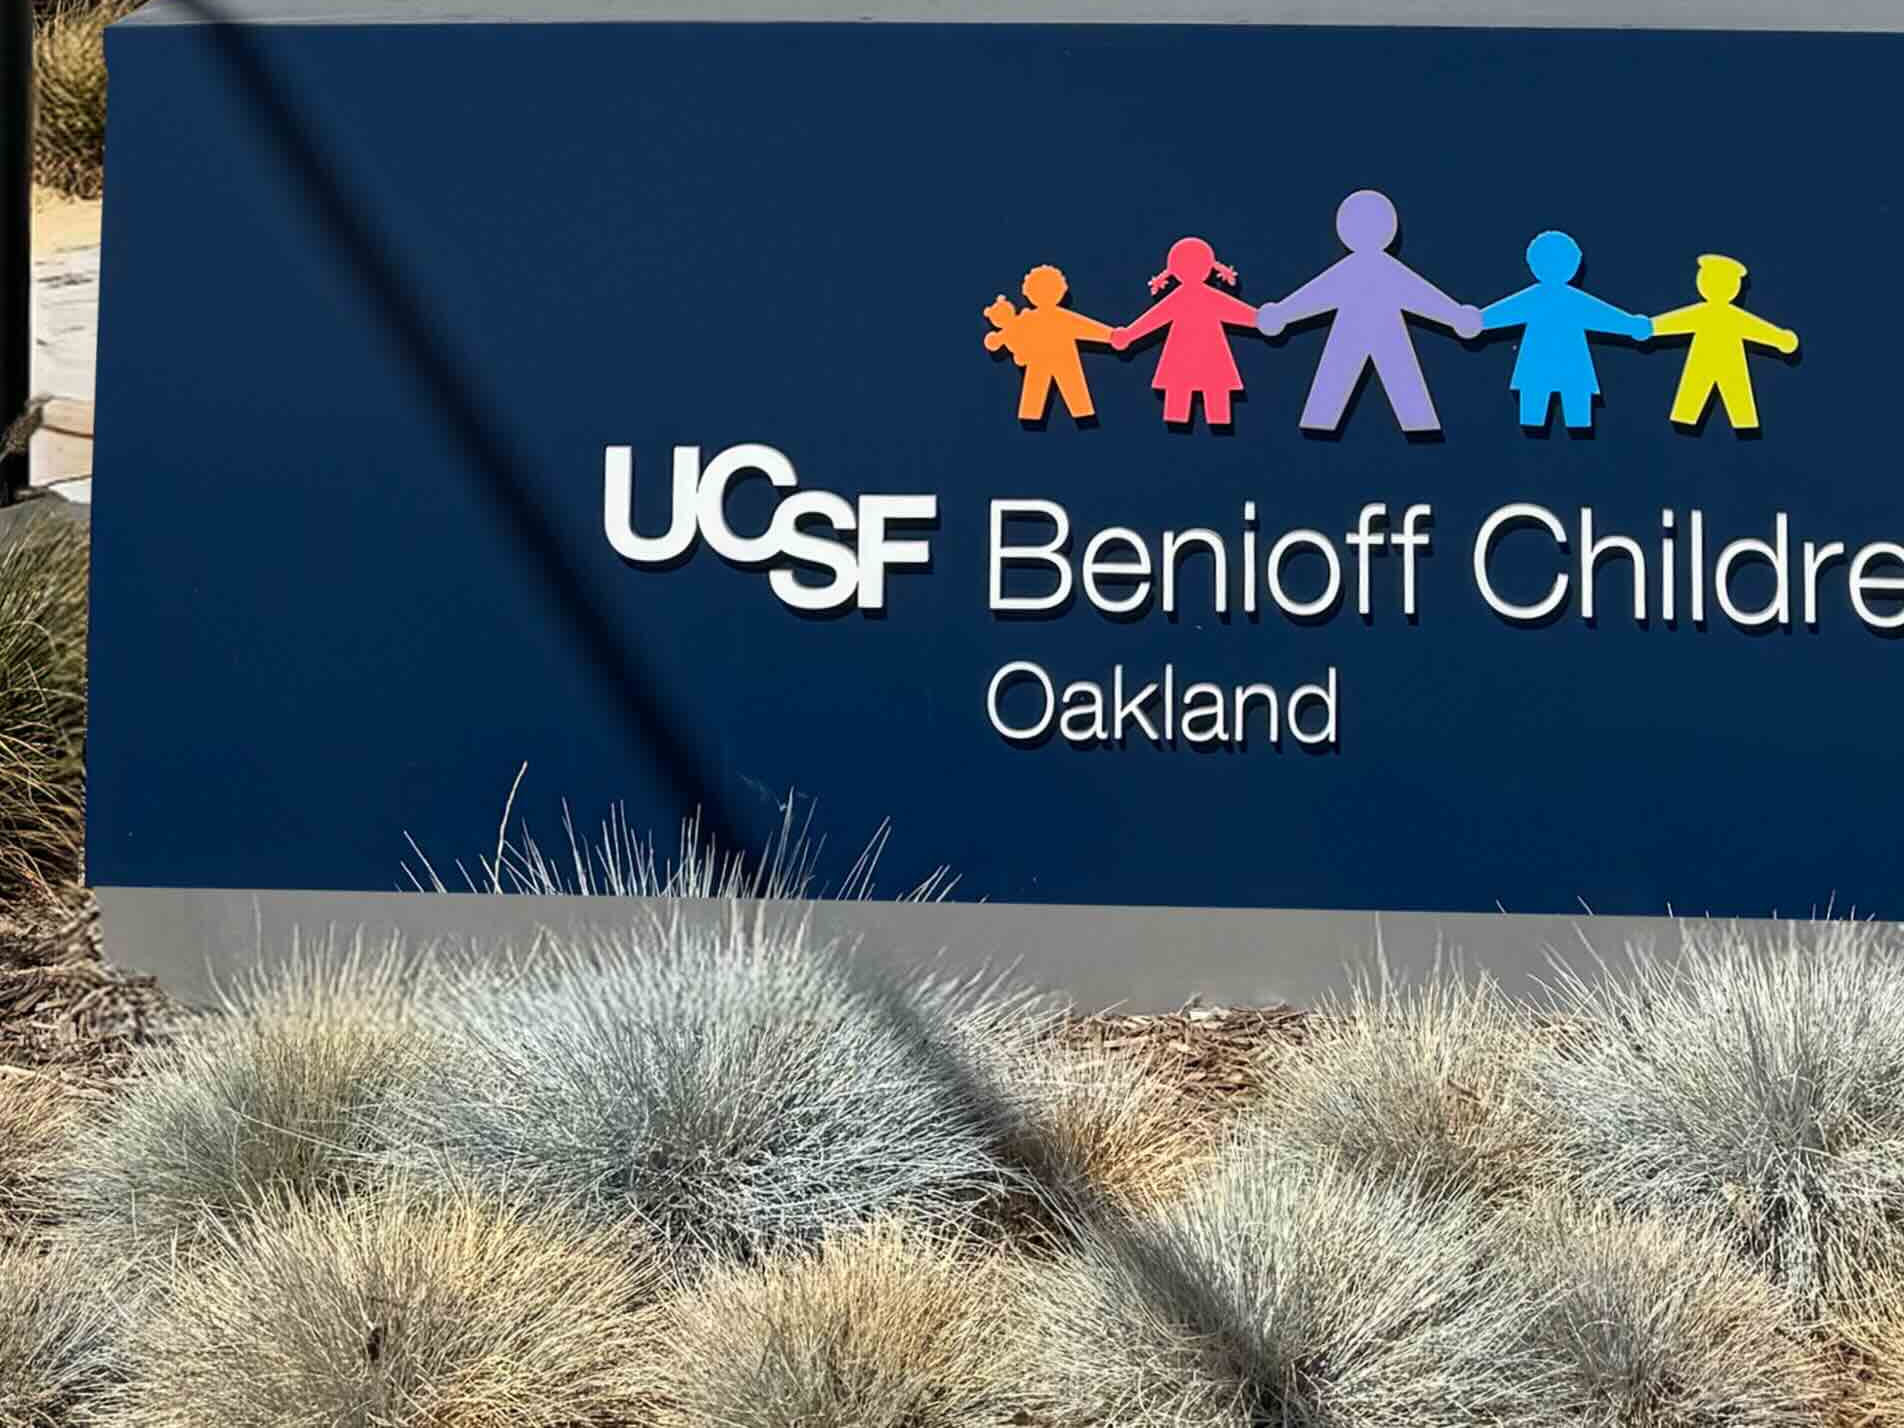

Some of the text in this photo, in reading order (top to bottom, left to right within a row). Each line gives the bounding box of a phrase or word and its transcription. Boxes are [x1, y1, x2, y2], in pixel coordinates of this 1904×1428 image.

[604, 444, 937, 610] UCSF
[988, 499, 1432, 616] Benioff
[986, 661, 1338, 744] Oakland
